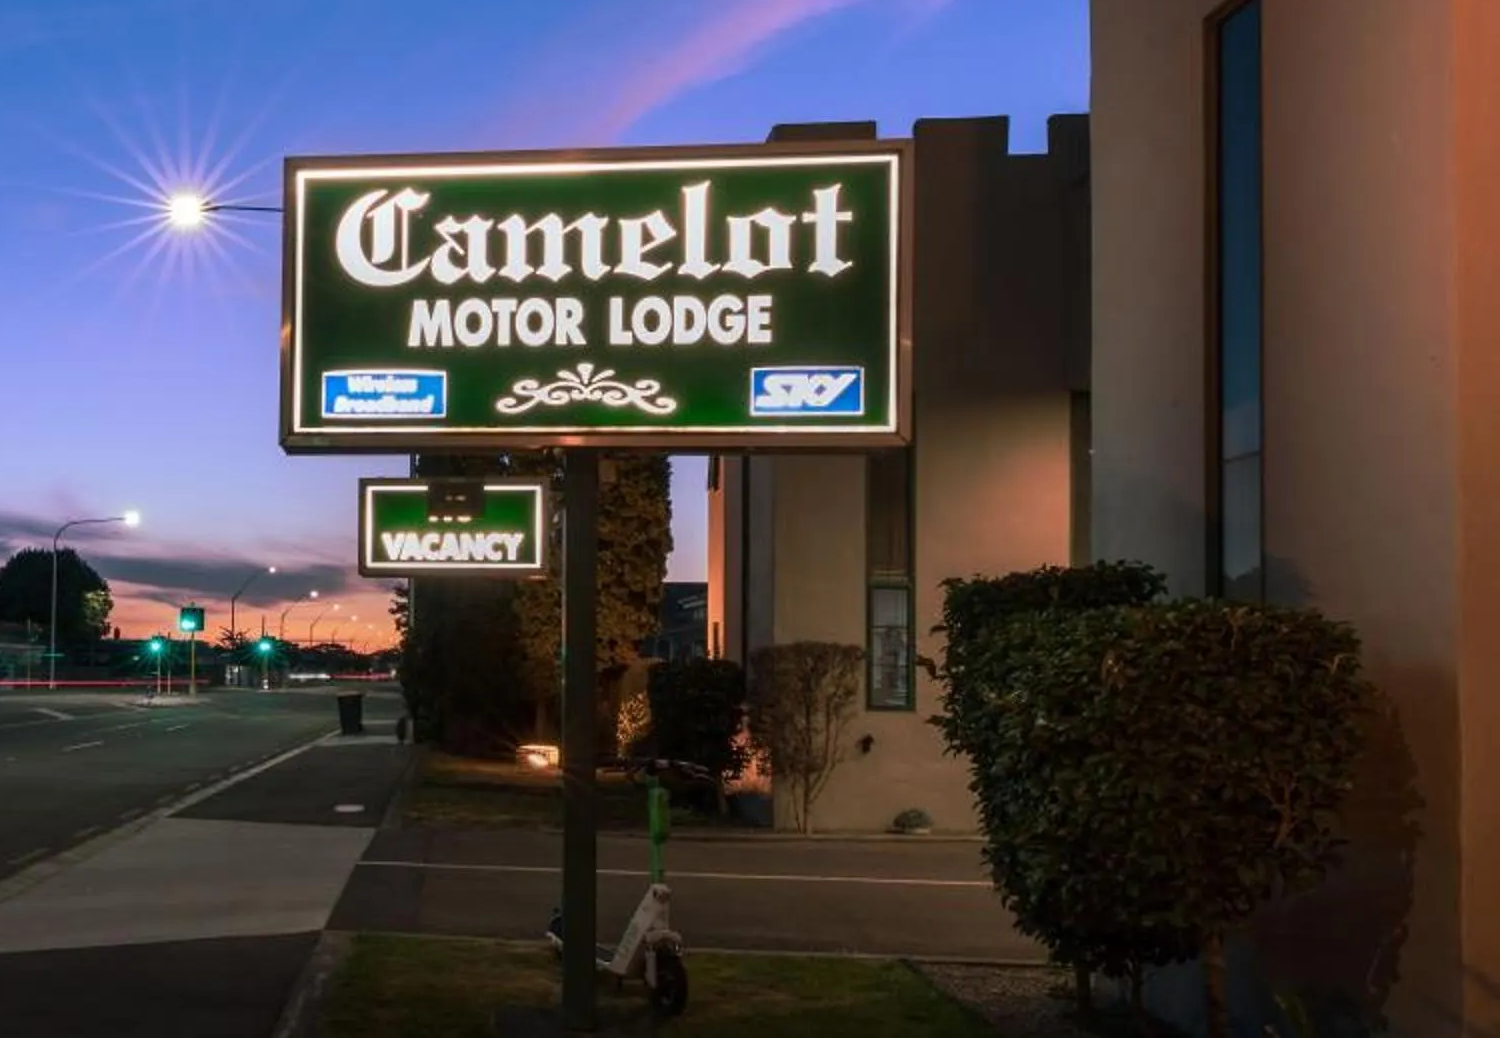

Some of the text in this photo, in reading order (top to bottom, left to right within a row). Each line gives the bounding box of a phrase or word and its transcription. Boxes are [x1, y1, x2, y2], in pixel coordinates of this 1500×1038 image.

[335, 179, 853, 287] Camelot
[408, 294, 773, 347] MOTOR LODGE
[755, 373, 857, 408] SKY
[381, 532, 524, 561] VACANCY
